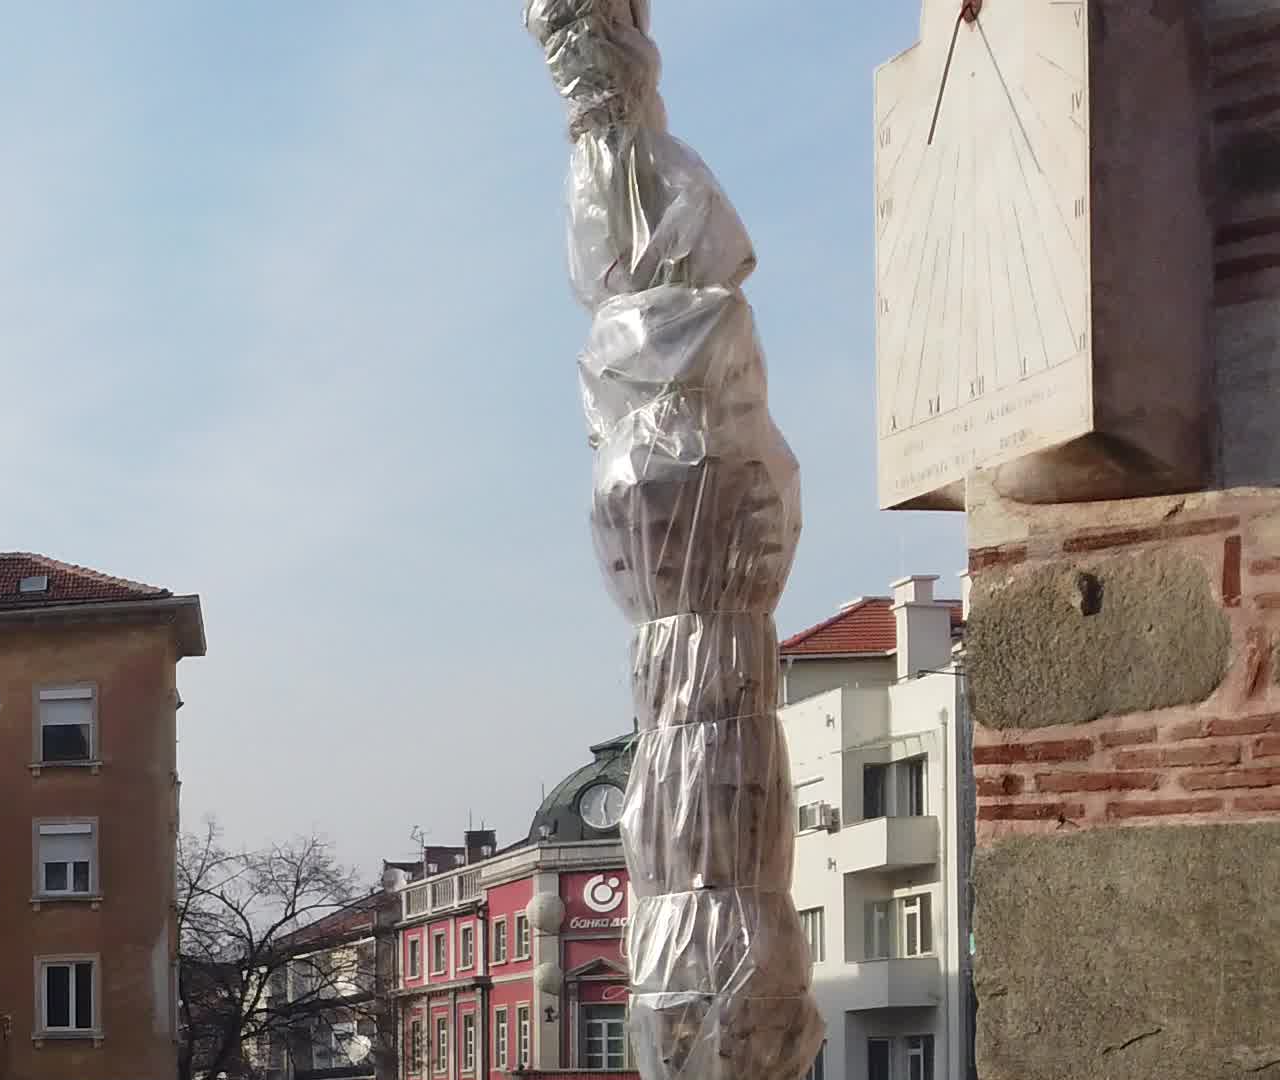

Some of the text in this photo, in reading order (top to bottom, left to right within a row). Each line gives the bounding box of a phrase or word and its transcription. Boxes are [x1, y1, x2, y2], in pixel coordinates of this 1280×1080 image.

[1070, 90, 1083, 113] IV
[1073, 197, 1085, 219] III
[570, 916, 609, 929] банка
